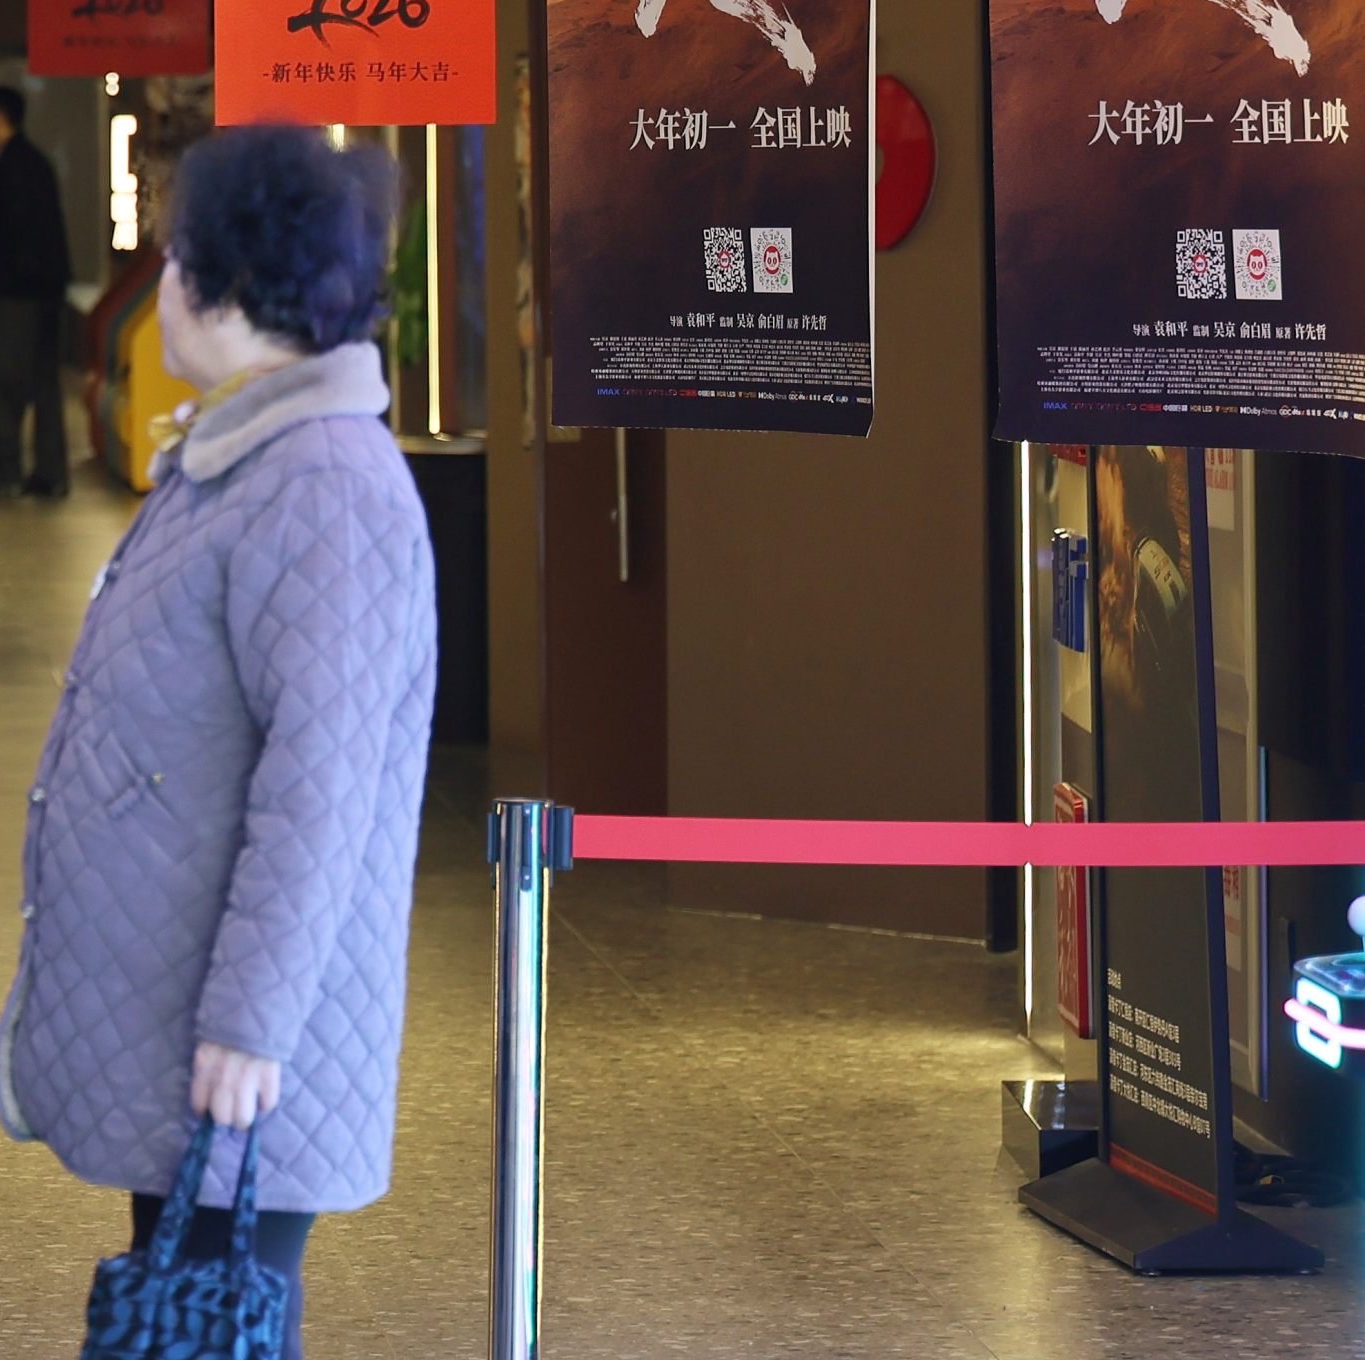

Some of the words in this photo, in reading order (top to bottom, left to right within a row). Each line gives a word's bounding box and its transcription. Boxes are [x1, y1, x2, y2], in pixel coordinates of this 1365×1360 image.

[629, 107, 736, 150] 大年初一
[750, 105, 852, 149] 全国上映
[1088, 99, 1214, 145] 大年初一
[1230, 98, 1349, 144] 全国上映
[1133, 324, 1150, 336] 导演
[1154, 321, 1188, 338] 袁和平
[1213, 322, 1235, 338] 吴京
[1043, 402, 1068, 410] IMAX
